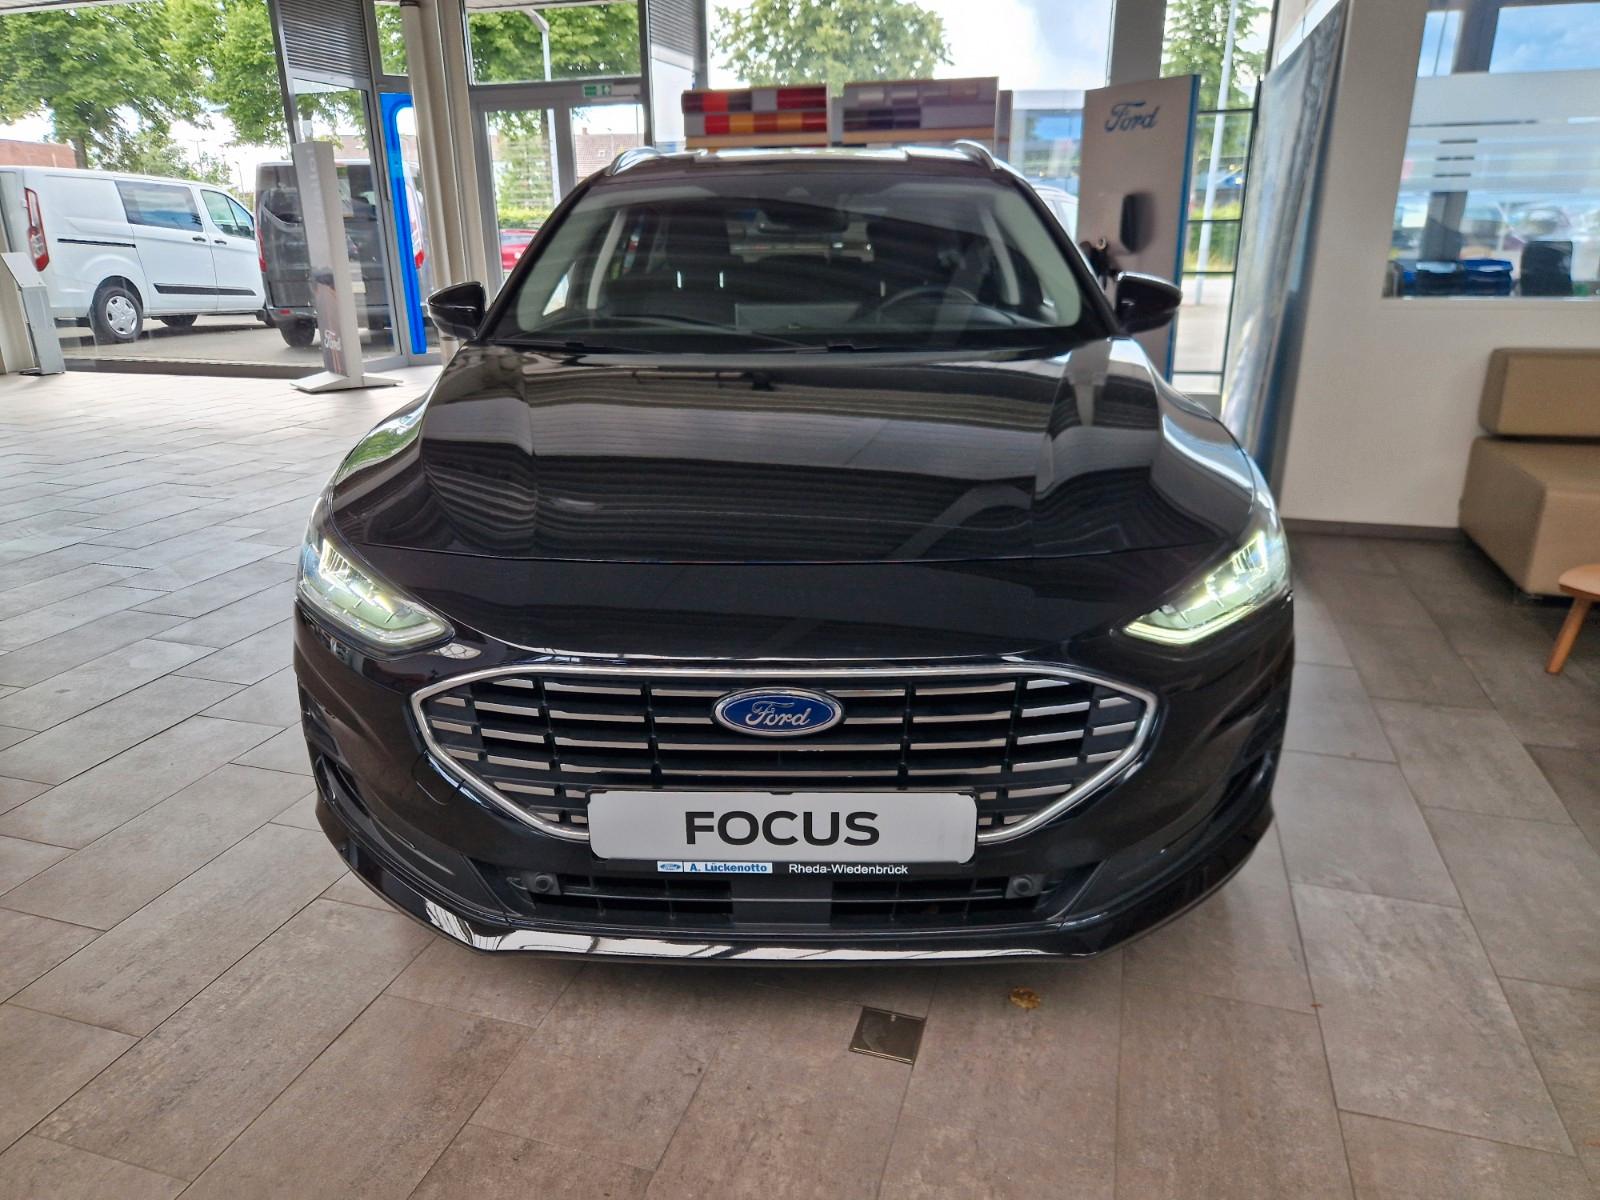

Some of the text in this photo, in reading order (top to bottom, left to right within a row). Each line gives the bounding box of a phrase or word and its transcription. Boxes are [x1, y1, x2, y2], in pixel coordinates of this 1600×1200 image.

[1104, 100, 1161, 132] Ford
[324, 329, 341, 351] Ford
[745, 700, 812, 726] Ford
[685, 810, 880, 846] FOCUS
[690, 863, 701, 872] A.
[704, 862, 768, 873] Lückenotto
[788, 863, 909, 875] Rheda-Wiedenbrück
